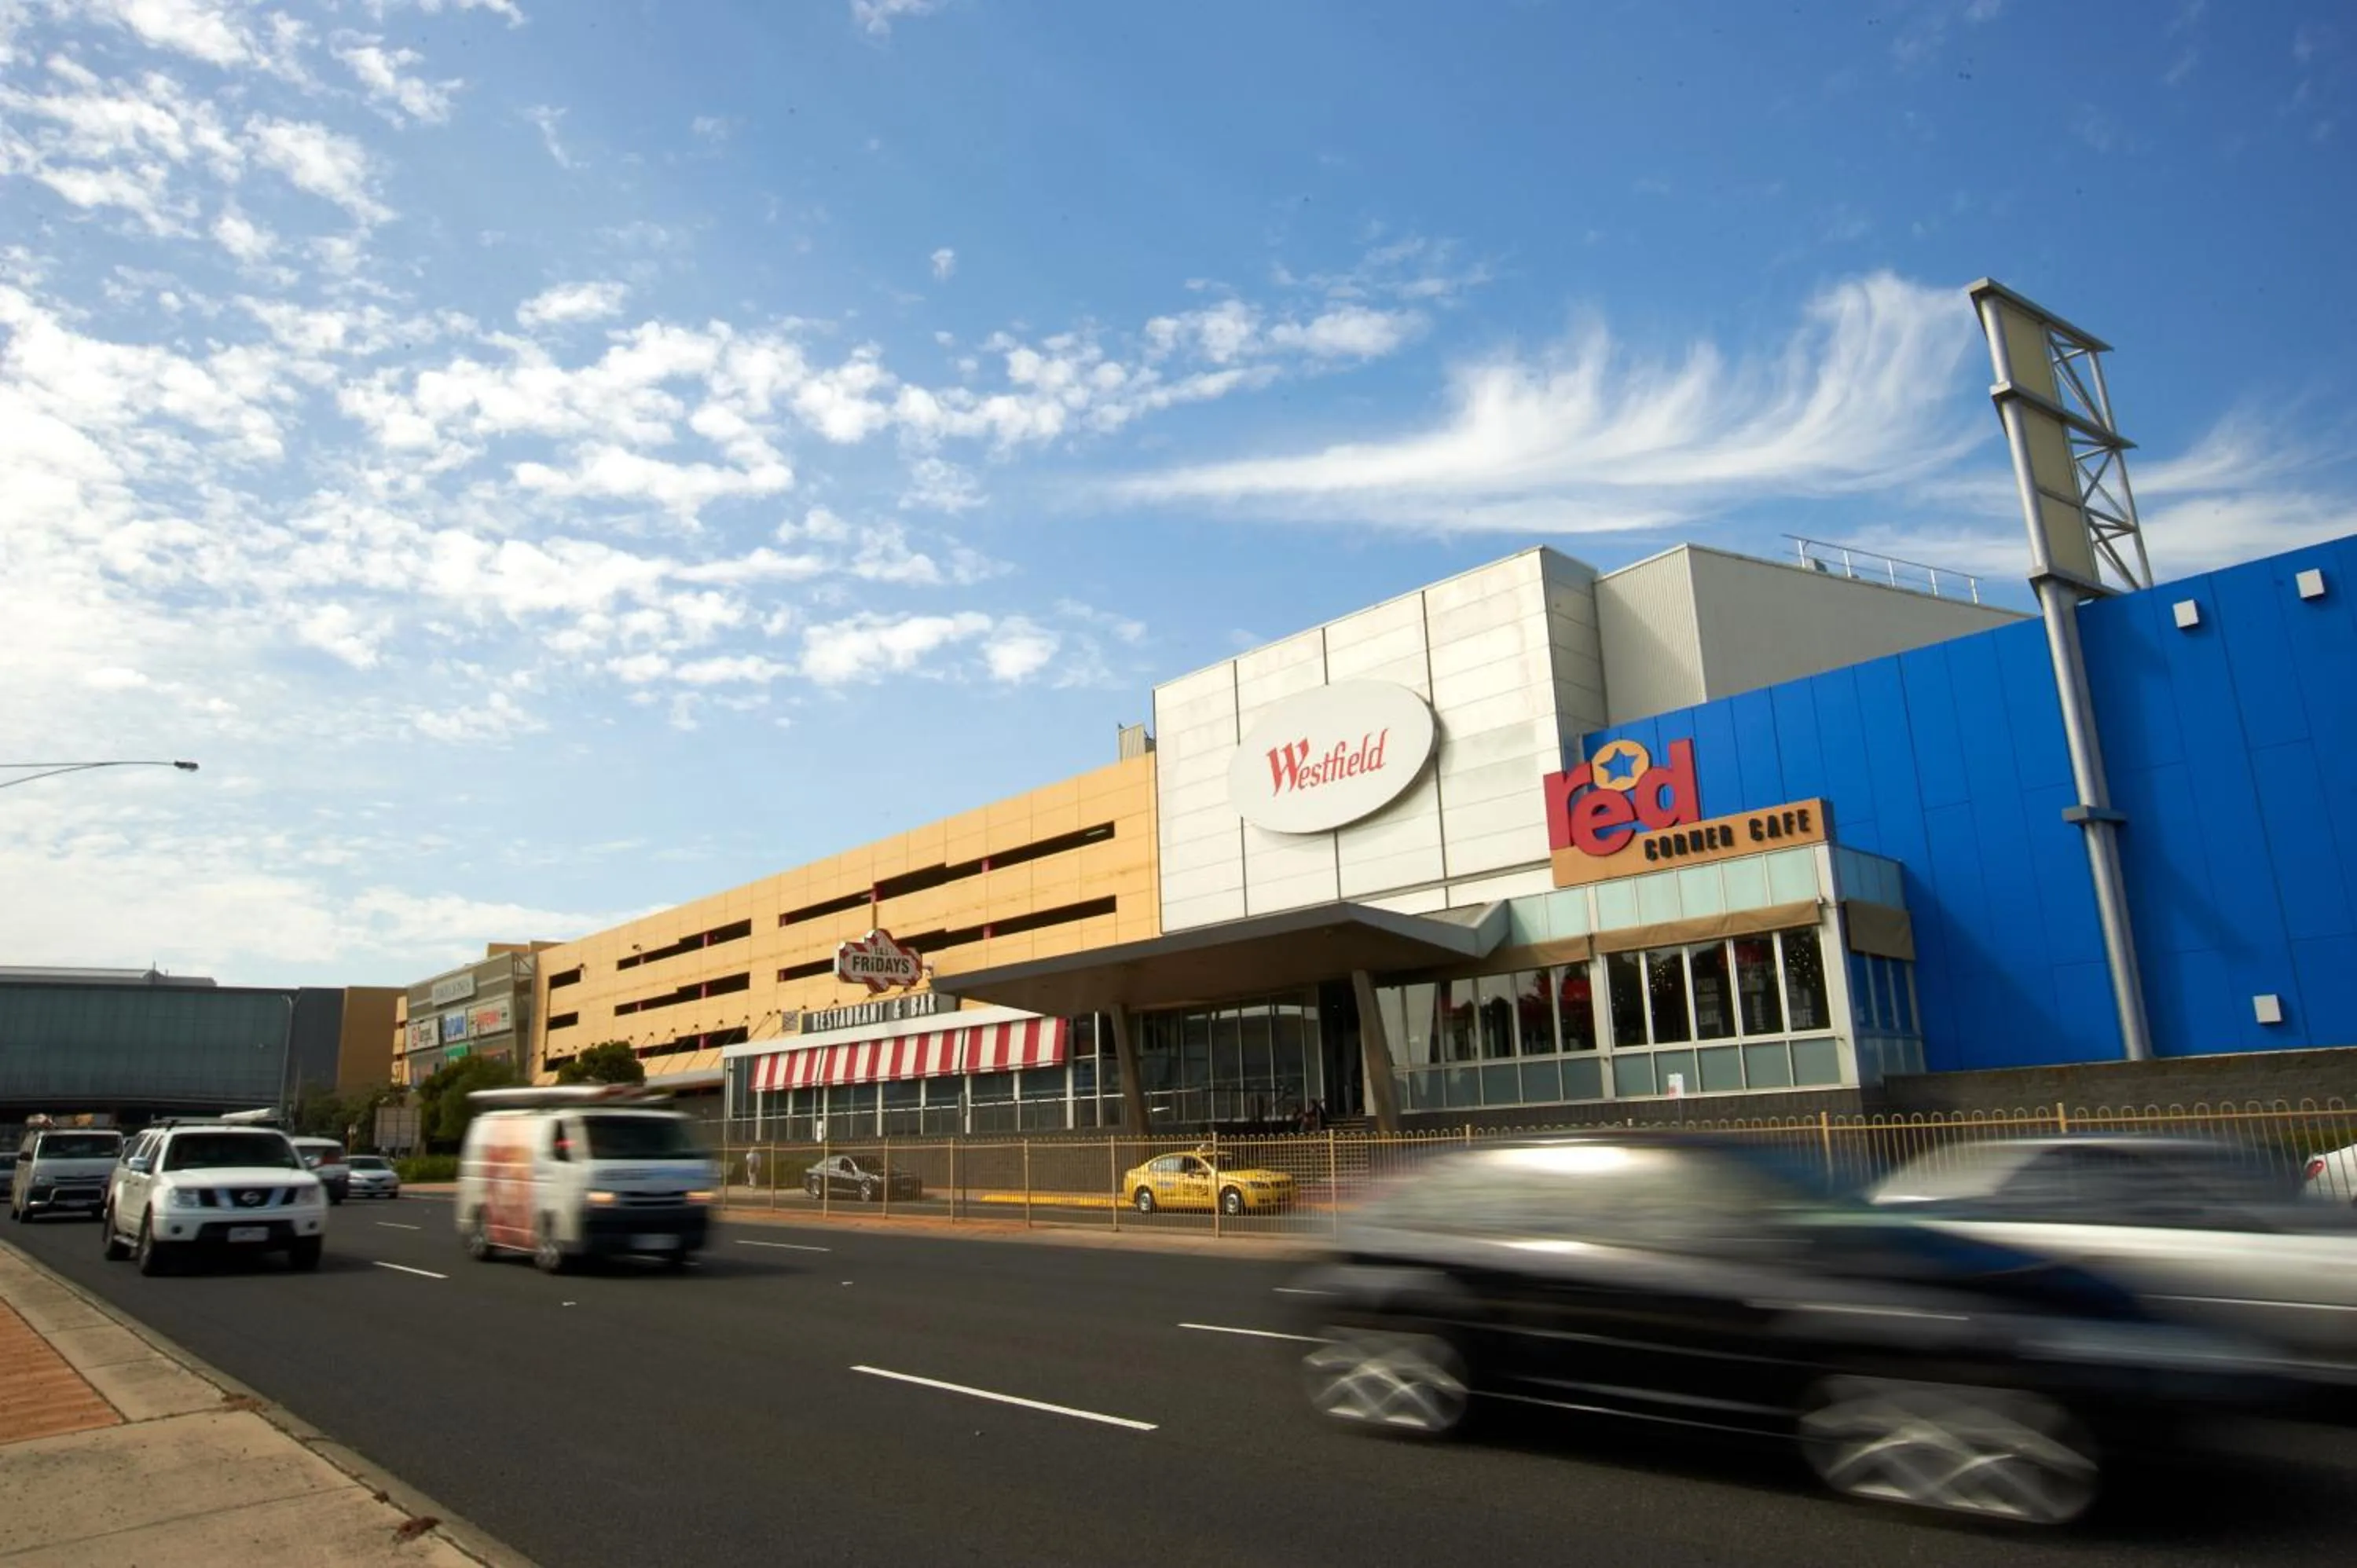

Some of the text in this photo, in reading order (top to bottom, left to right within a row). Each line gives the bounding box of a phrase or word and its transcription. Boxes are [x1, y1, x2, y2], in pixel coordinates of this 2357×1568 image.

[1266, 727, 1389, 797] Westfield
[1543, 738, 1701, 856] red
[1644, 808, 1811, 861] CORNER CAFE
[812, 993, 935, 1031] RESTAURANT & BAR
